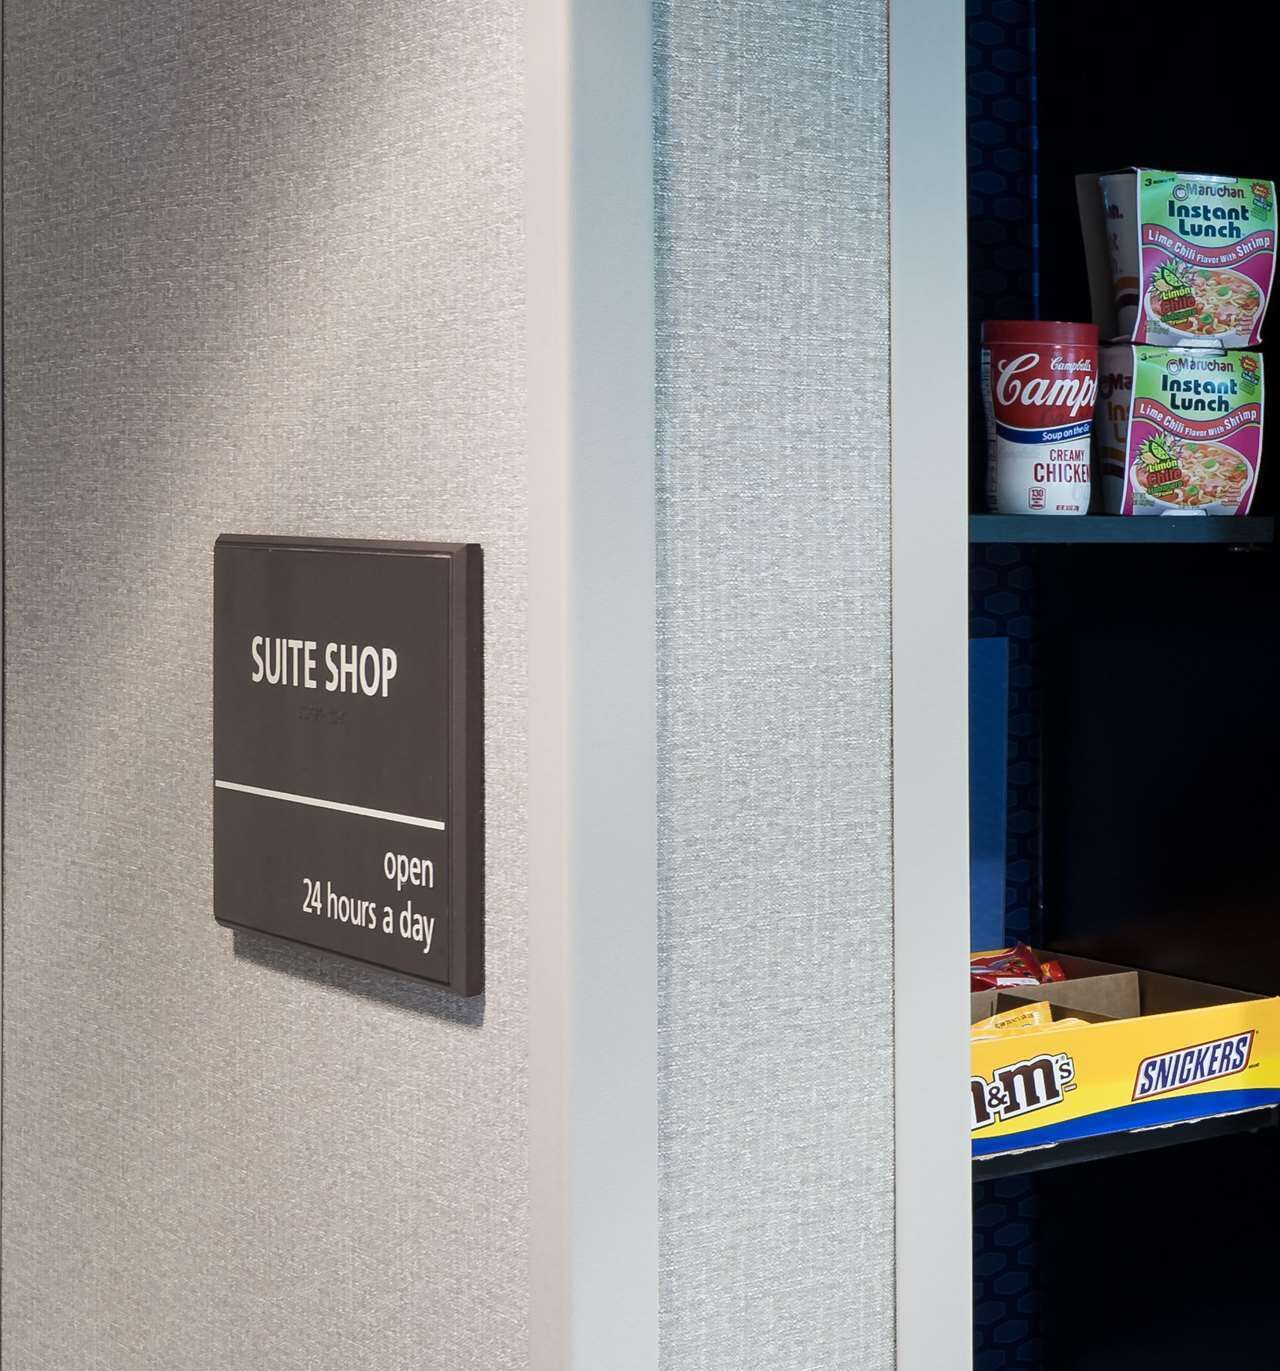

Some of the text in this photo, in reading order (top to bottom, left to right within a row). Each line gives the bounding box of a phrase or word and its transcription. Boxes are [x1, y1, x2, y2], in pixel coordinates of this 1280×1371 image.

[1186, 183, 1244, 198] Maruchan
[1168, 200, 1249, 221] Instant
[1178, 219, 1241, 239] Lunch
[1148, 229, 1173, 248] Lime
[1175, 241, 1195, 260] Chili
[1236, 236, 1270, 257] Shrimp
[1179, 358, 1234, 373] Maruchan
[1162, 375, 1237, 395] Instant
[1170, 393, 1230, 412] Lunch
[1140, 403, 1163, 421] Lime
[1164, 417, 1184, 434] Chili
[1185, 427, 1207, 437] Flavor
[1224, 409, 1257, 430] Shrimp
[1042, 429, 1063, 441] Soup
[1064, 429, 1073, 438] on
[1050, 449, 1085, 462] CREAMY
[252, 636, 398, 697] SUITE SHOP
[384, 851, 434, 891] open
[302, 878, 435, 954] 24 hours a day
[1140, 1034, 1248, 1095] SNICKERS
